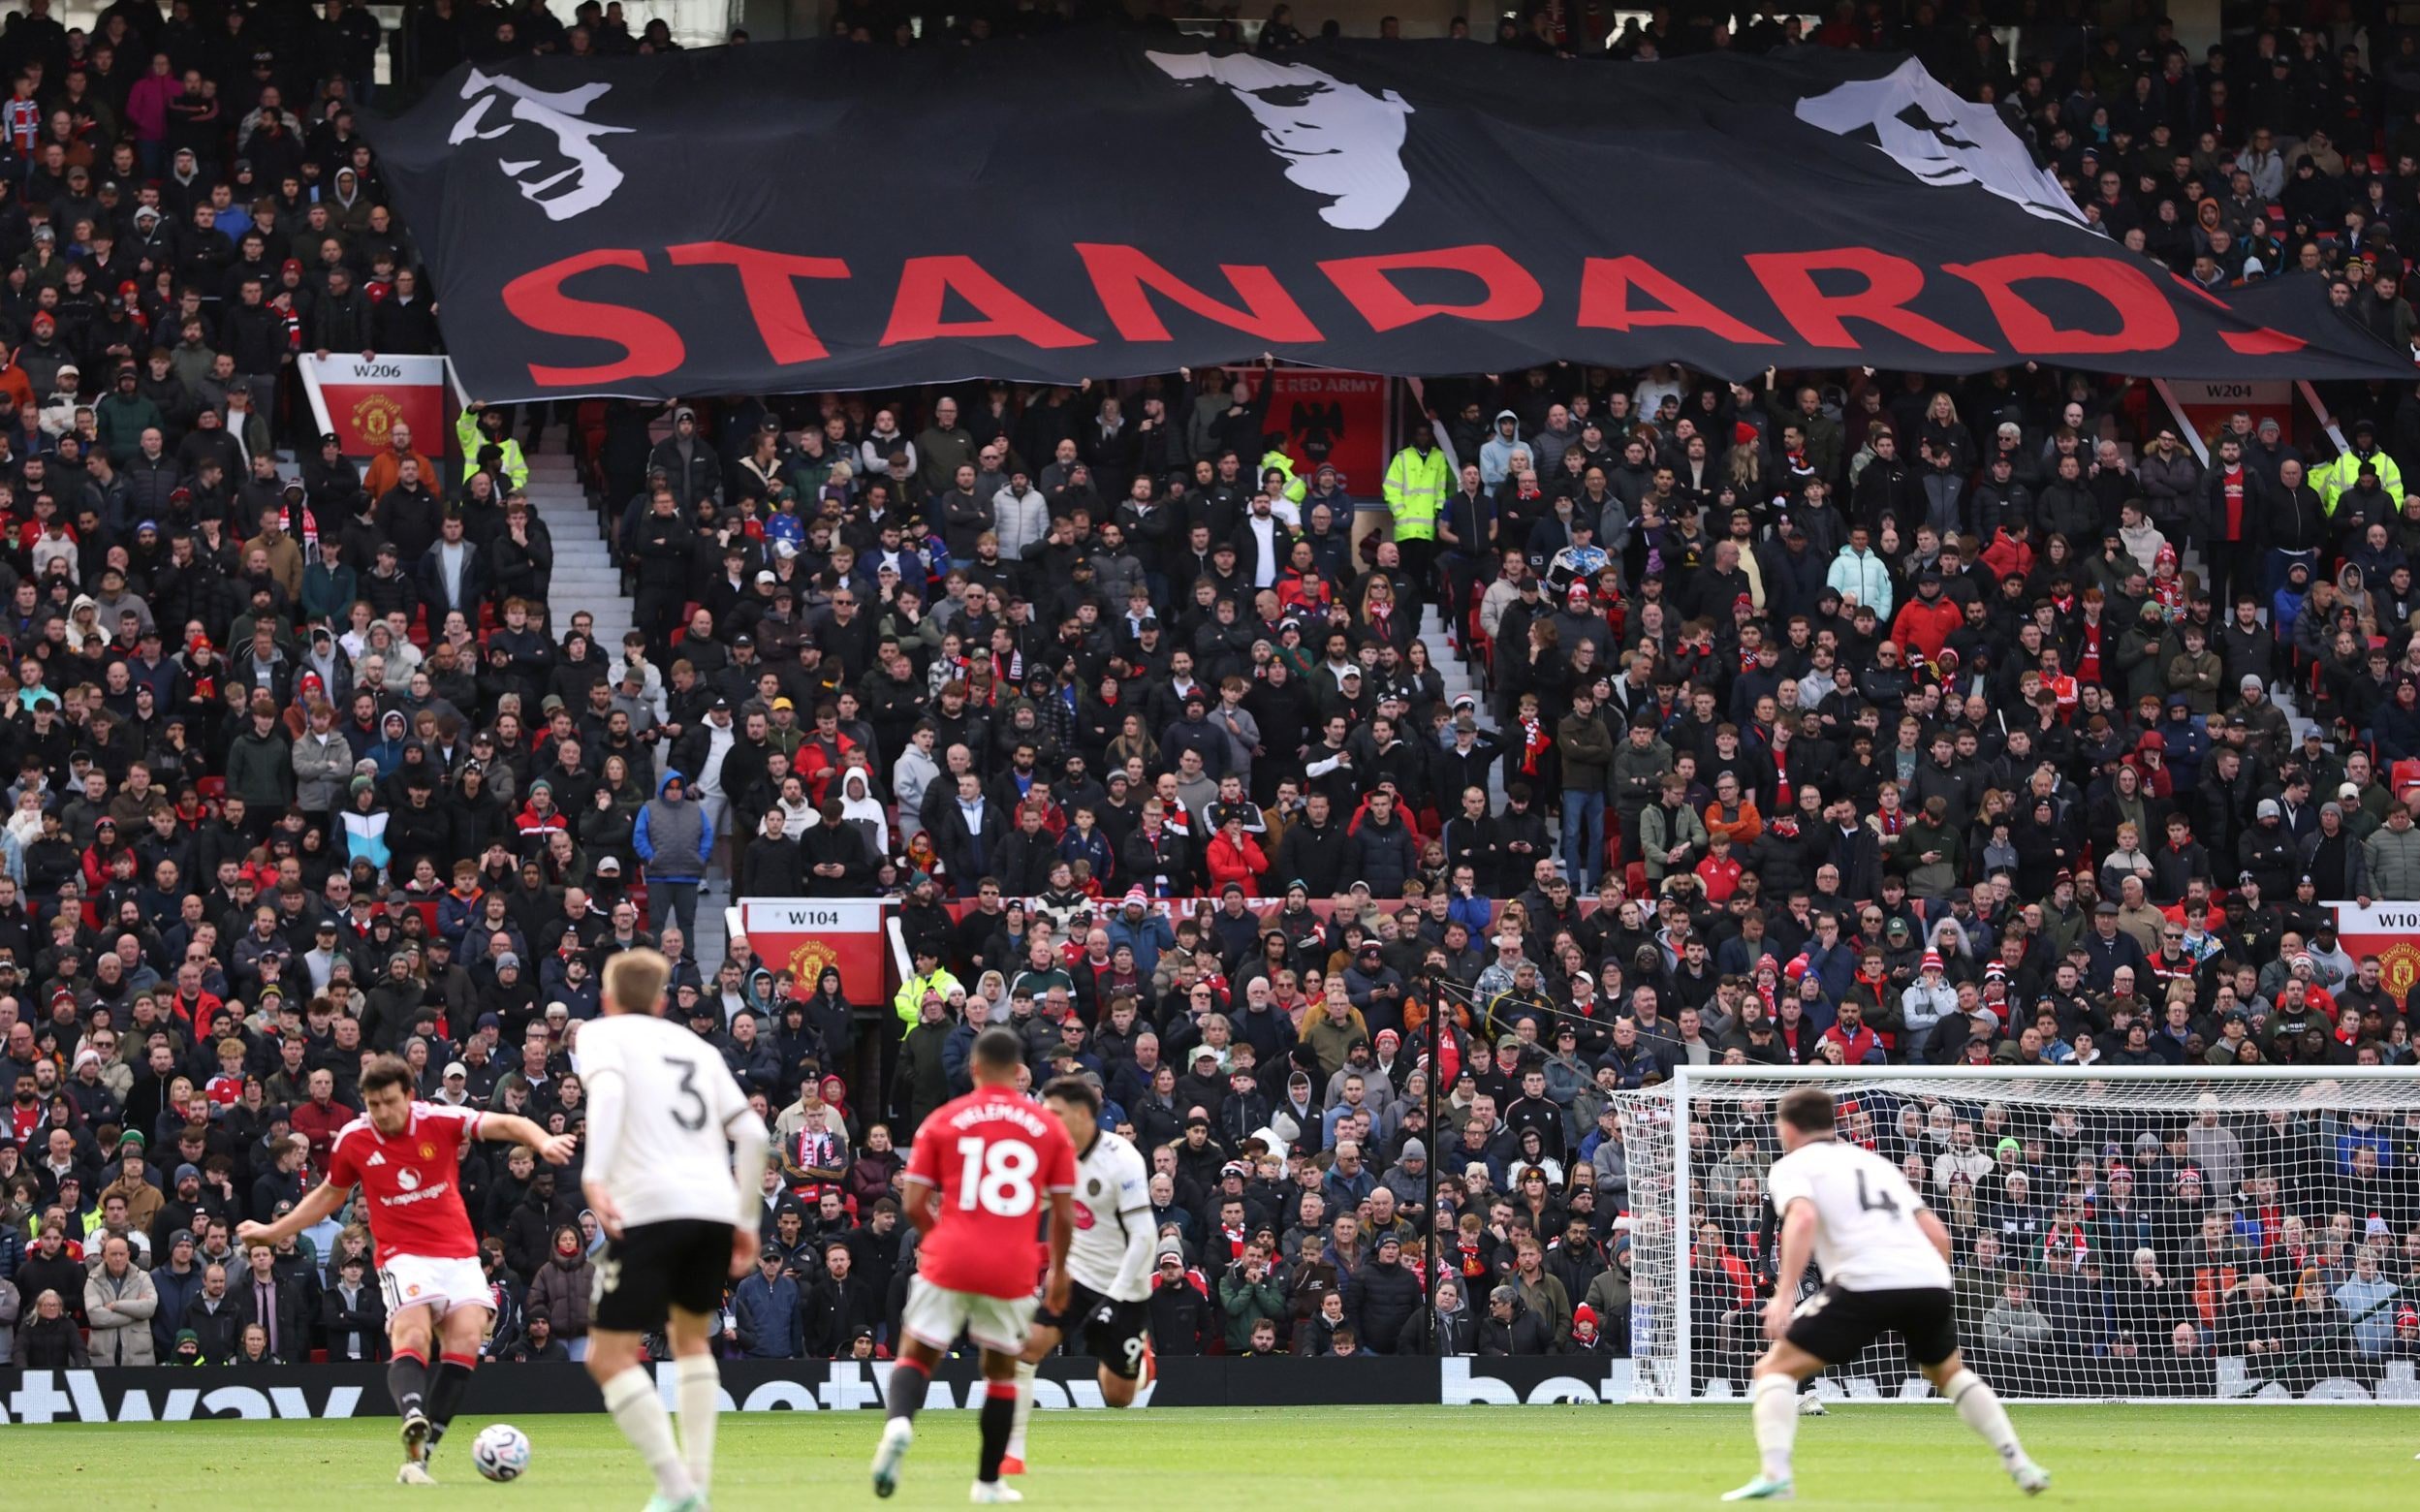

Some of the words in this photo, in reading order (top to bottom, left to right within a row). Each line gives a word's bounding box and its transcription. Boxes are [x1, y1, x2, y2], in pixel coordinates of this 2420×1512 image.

[354, 364, 401, 378] W206
[1252, 379, 1284, 392] TE
[1288, 379, 1322, 393] RED
[1325, 379, 1379, 394] ARMY
[2207, 384, 2253, 397] W204
[789, 911, 839, 925] W104
[2378, 914, 2420, 928] W10
[2381, 945, 2420, 964] MANCHESTE
[662, 1055, 707, 1130] 3
[957, 1136, 1039, 1217] 18
[1855, 1168, 1901, 1219] 4
[1123, 1337, 1143, 1365] 9
[0, 1369, 364, 1425] twa
